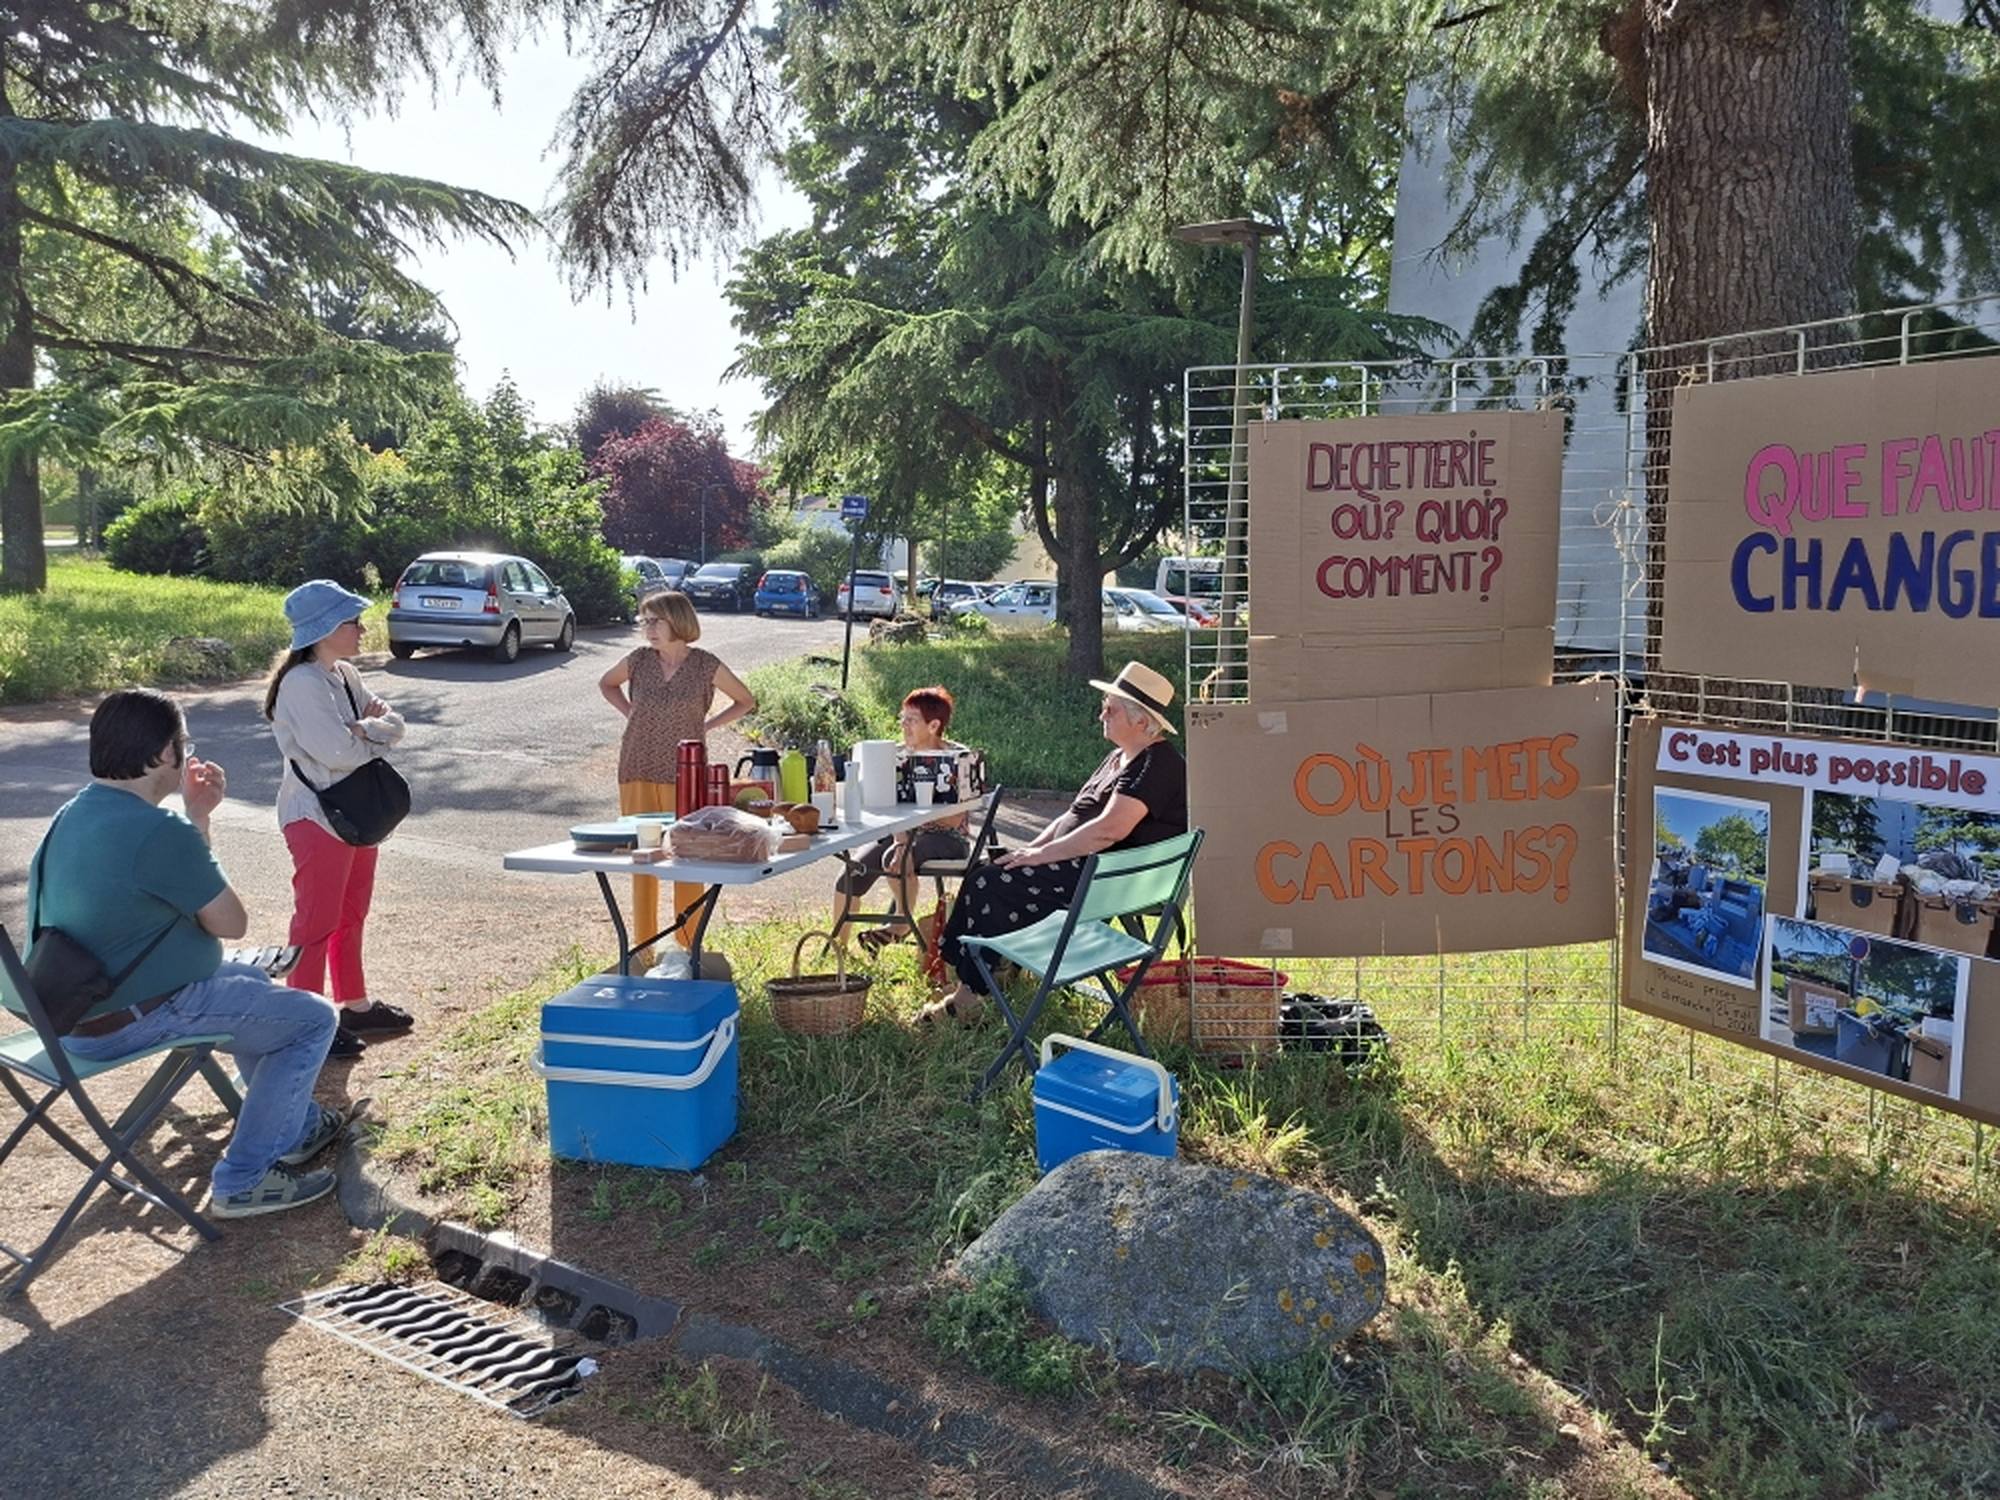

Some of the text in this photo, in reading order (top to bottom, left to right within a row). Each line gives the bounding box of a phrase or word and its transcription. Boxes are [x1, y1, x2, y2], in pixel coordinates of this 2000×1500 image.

[1744, 443, 1869, 536] QUE
[1316, 546, 1503, 602] COMMENT?
[1294, 733, 1580, 817] OÙ JE METS
[1668, 732, 1987, 796] C'est plus possible
[1385, 804, 1461, 838] LES
[1254, 823, 1579, 905] CARTONS?
